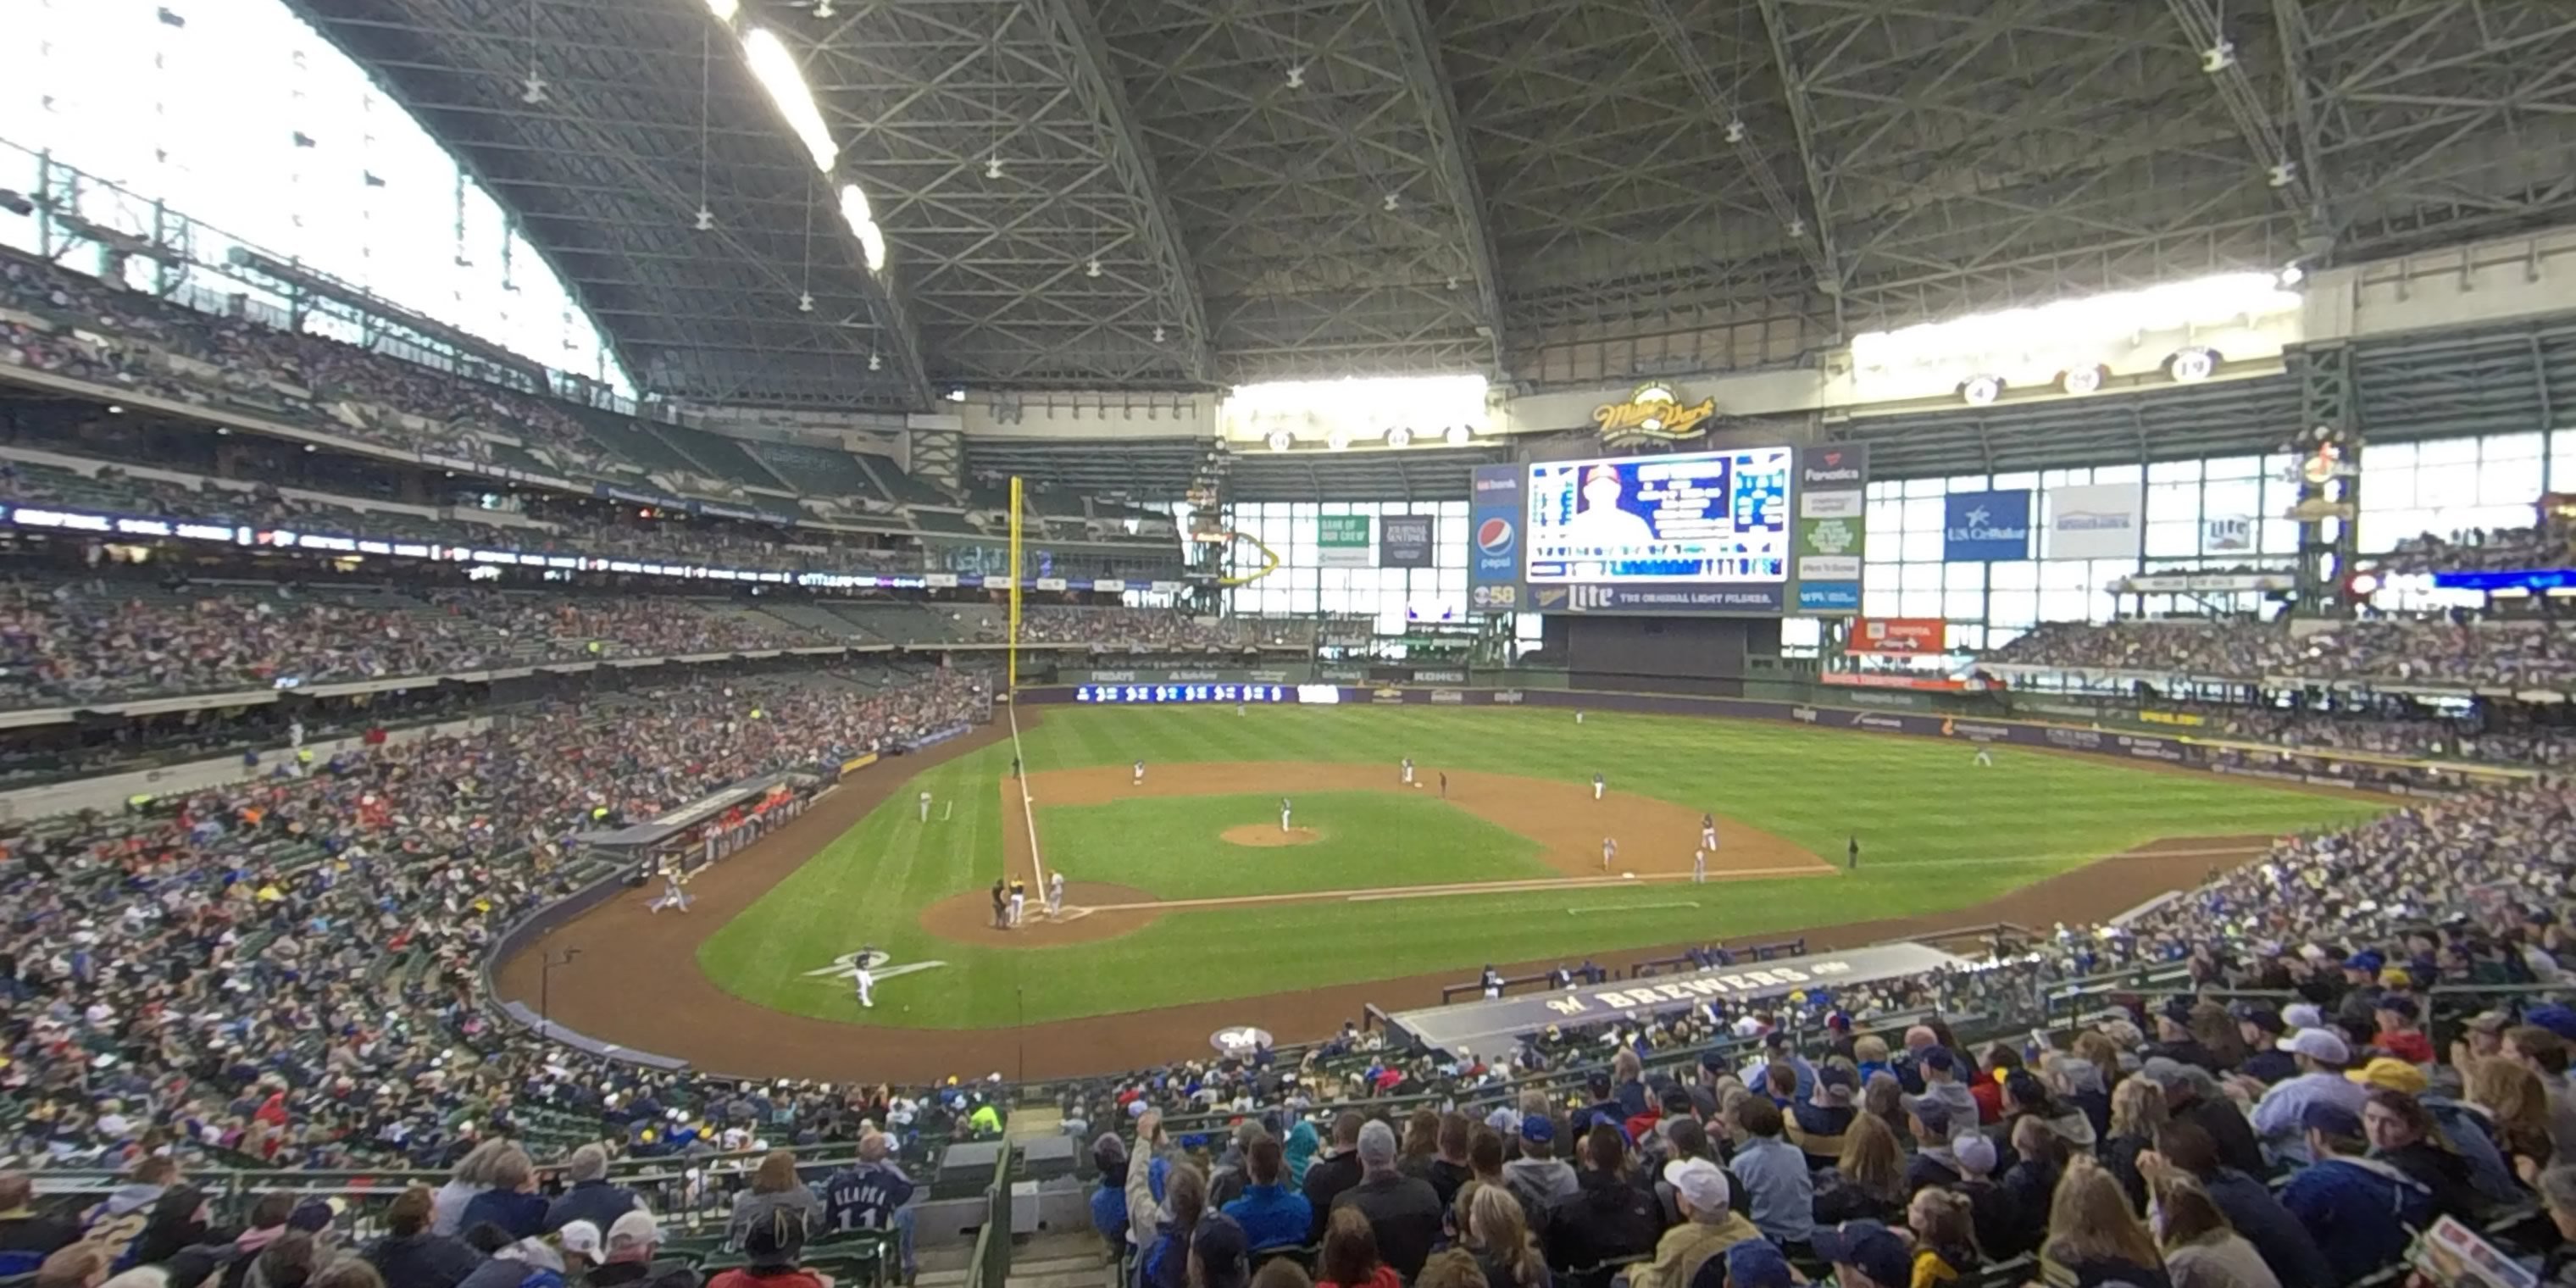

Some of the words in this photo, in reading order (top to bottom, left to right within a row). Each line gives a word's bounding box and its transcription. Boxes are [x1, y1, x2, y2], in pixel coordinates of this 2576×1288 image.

[1805, 467, 1859, 481] Fanatics
[1322, 519, 1343, 530] BANK
[1345, 519, 1356, 530] OF
[1322, 531, 1338, 541] OUR
[1341, 530, 1366, 541] CREW
[1481, 556, 1512, 570] pepsi
[1490, 586, 1515, 604] 58
[1568, 585, 1613, 612] Lite
[1619, 593, 1640, 602] THE
[1641, 593, 1690, 603] ORIGINAL
[1691, 593, 1724, 603] LIGHT
[1595, 967, 1811, 1009] BREWERS
[837, 1208, 877, 1232] 11
